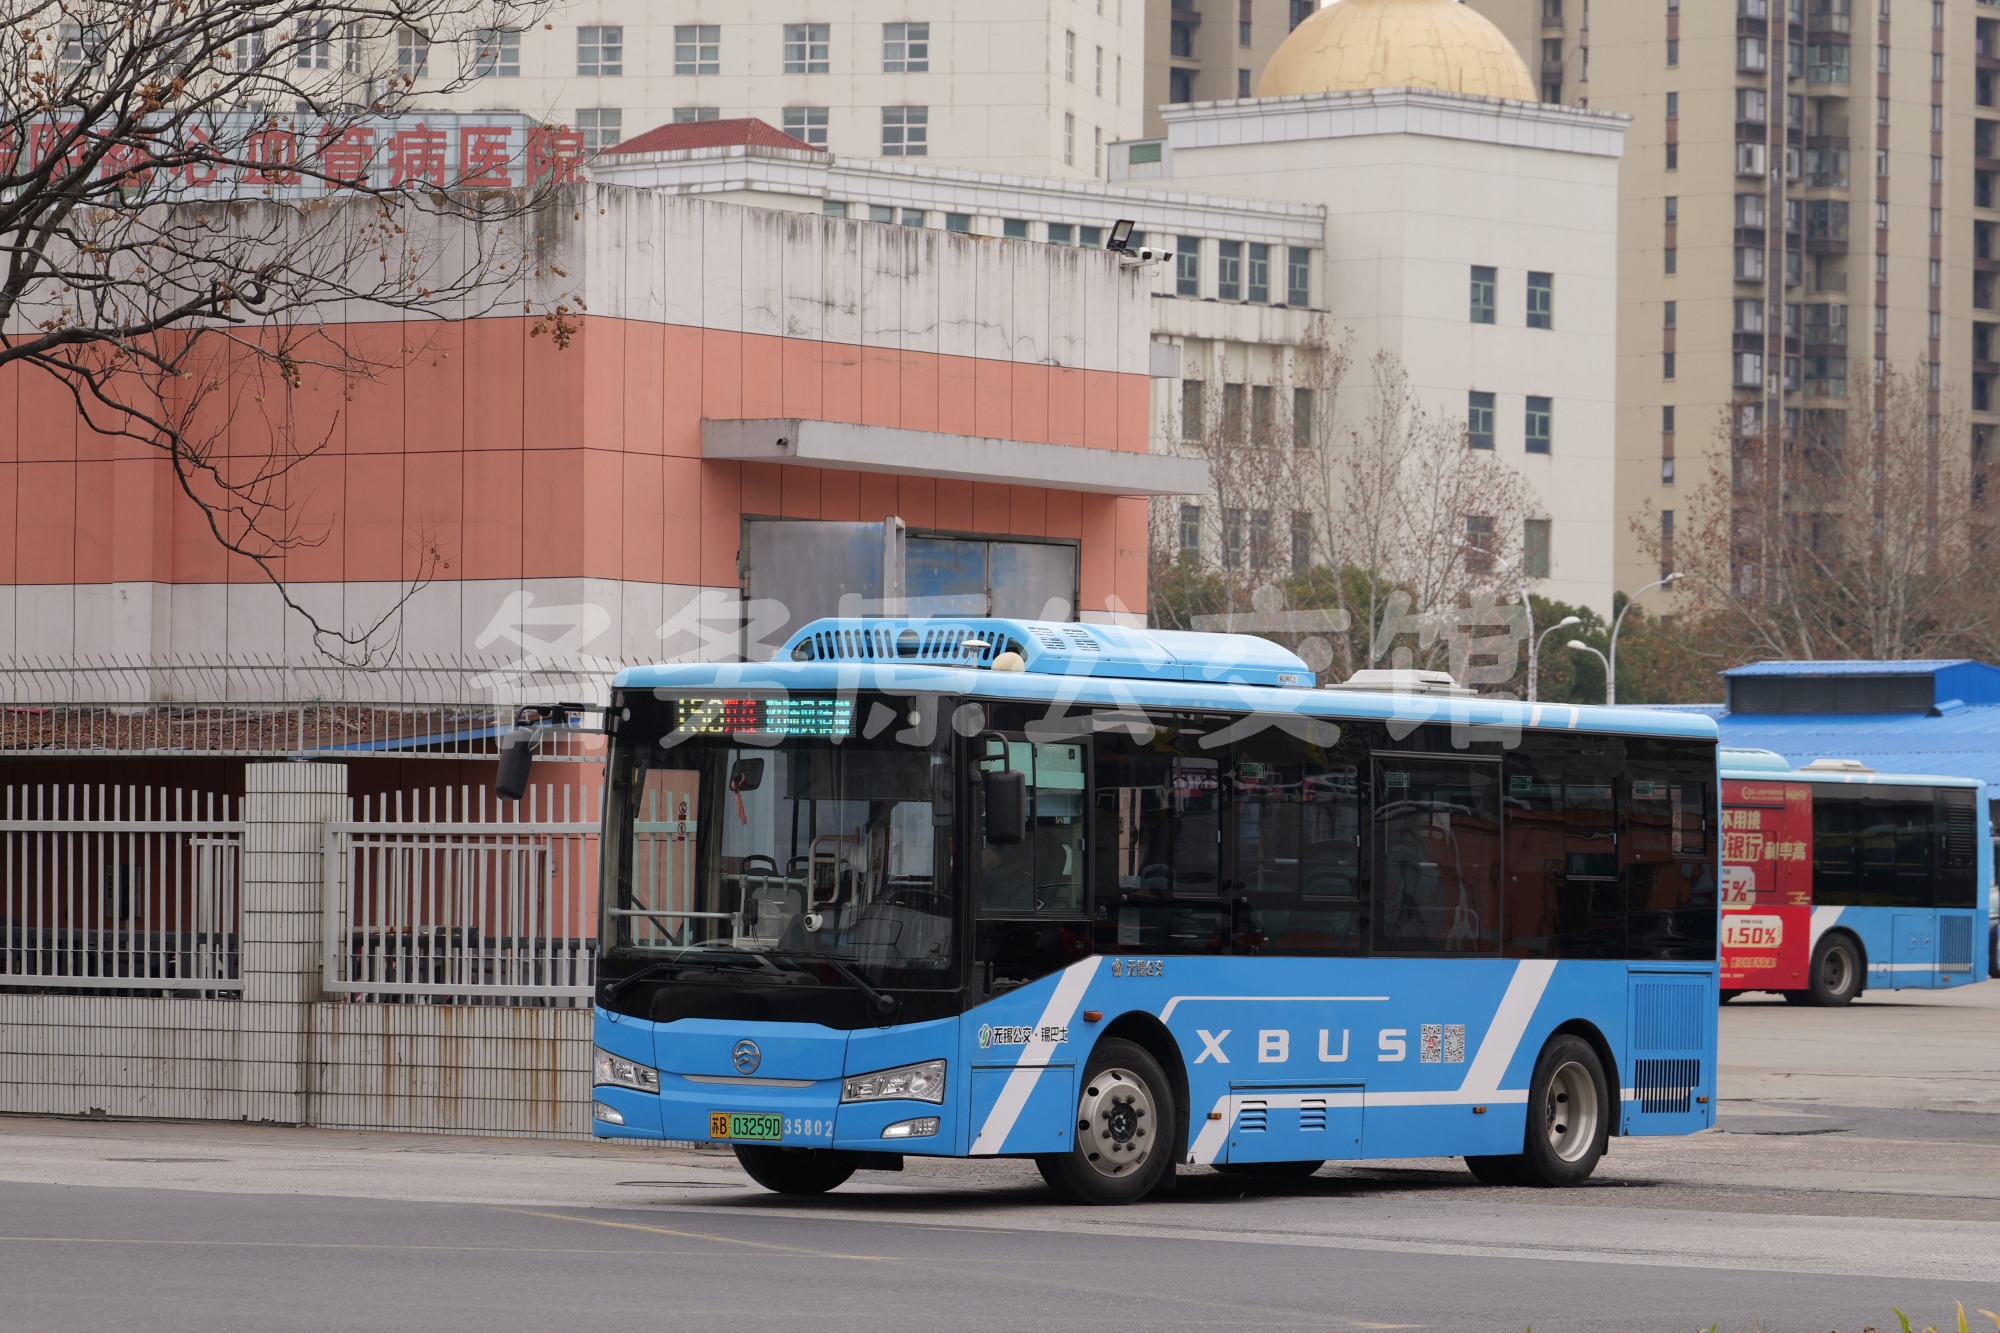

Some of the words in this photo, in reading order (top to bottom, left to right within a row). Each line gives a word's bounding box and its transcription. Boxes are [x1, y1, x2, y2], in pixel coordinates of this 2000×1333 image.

[1764, 841, 1807, 861] 利率高
[1727, 927, 1776, 944] 1.50%
[784, 1117, 833, 1138] 35802
